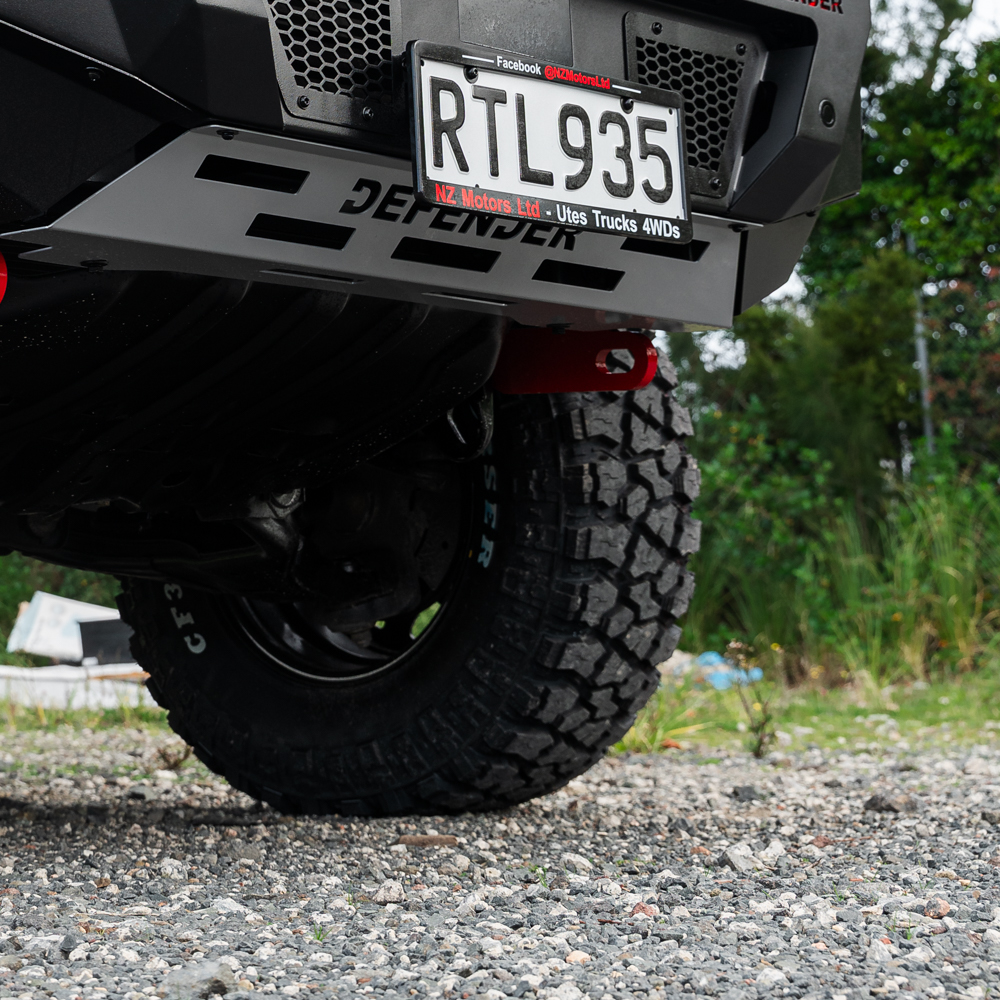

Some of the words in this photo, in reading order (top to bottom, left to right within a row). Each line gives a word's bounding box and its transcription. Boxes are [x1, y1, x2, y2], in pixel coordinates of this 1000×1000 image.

[496, 55, 541, 75] Facebook
[544, 65, 610, 89] @NZMotorsLtd
[429, 75, 674, 203] RTL935
[435, 183, 457, 205] NZ
[461, 188, 512, 214] Motors
[517, 197, 540, 219] Ltd
[556, 204, 587, 226] Utes
[592, 209, 638, 233] Trucks
[642, 217, 681, 239] 4WDs
